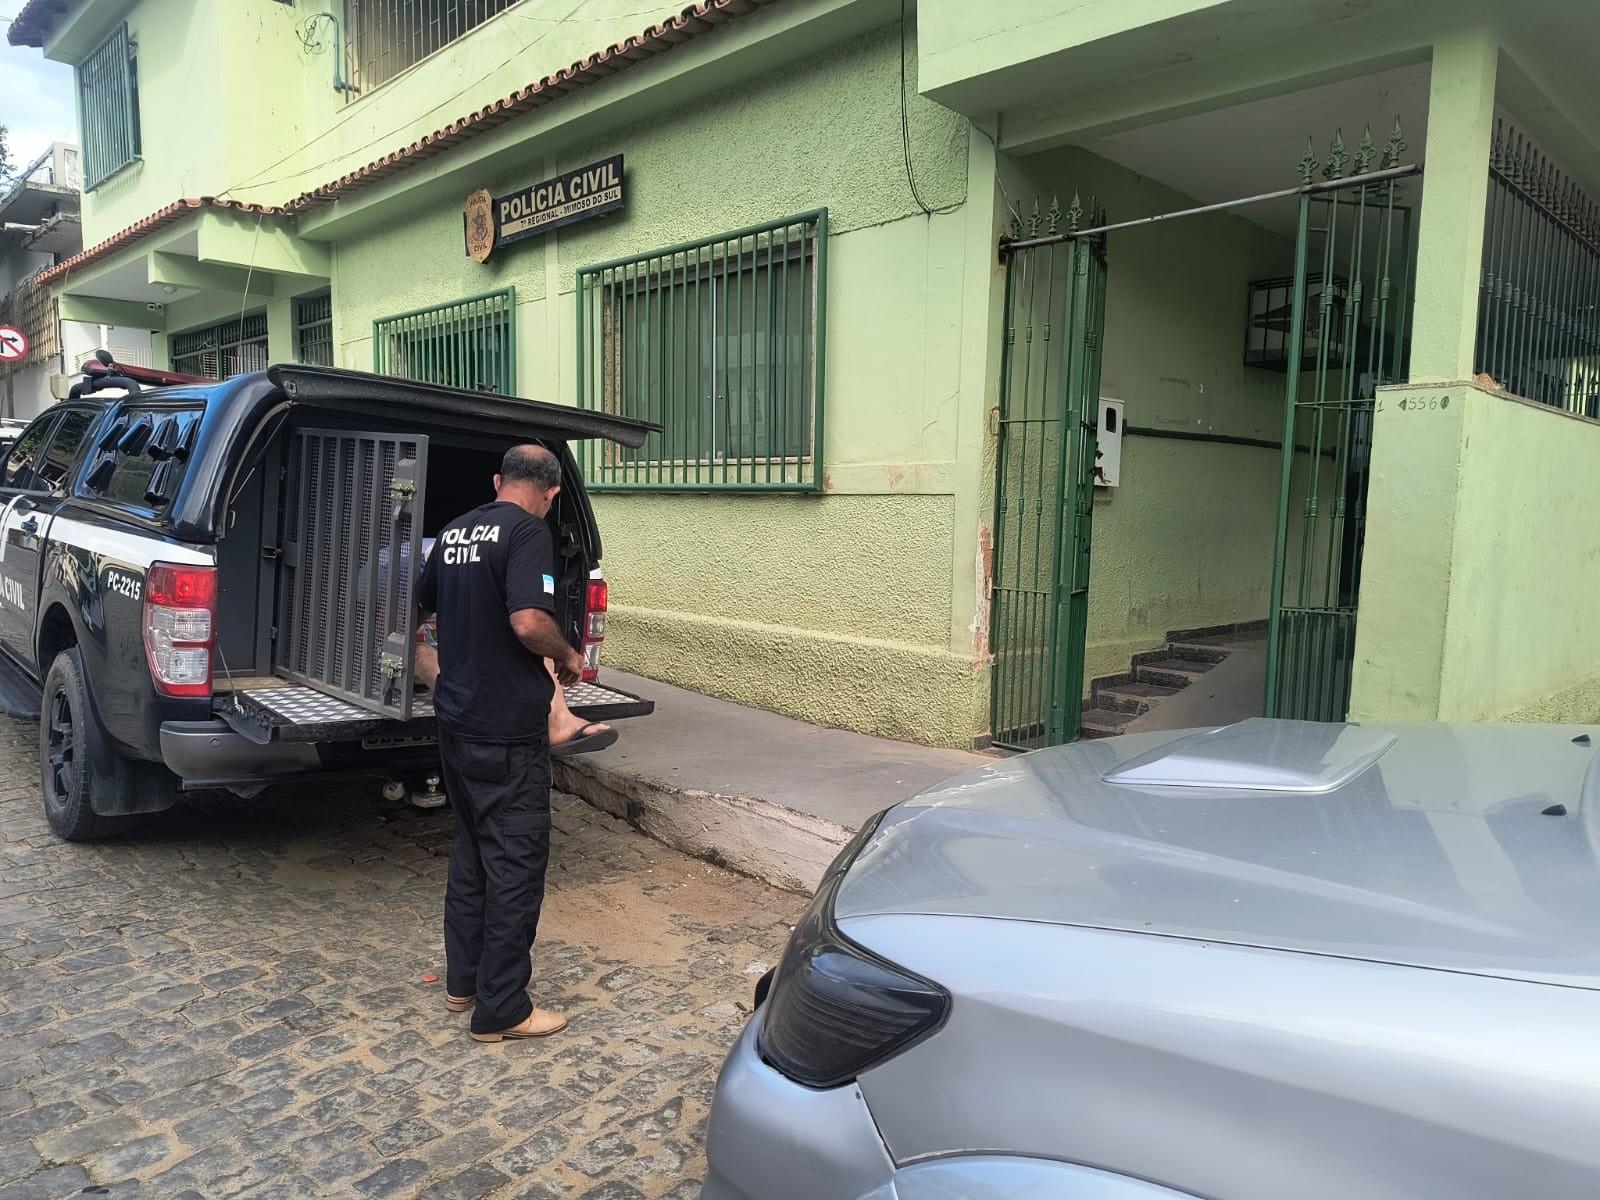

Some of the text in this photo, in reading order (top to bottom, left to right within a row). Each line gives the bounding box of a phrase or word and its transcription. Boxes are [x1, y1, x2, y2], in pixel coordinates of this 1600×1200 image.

[500, 162, 620, 223] POLÍCIA CIVIL
[527, 209, 559, 226] REGIONAL
[563, 198, 591, 215] MIMOSO
[592, 194, 602, 205] DO
[603, 189, 618, 201] SUL
[473, 242, 488, 252] CIVIL
[4, 575, 25, 611] CIVIL
[107, 570, 142, 601] PC-2215
